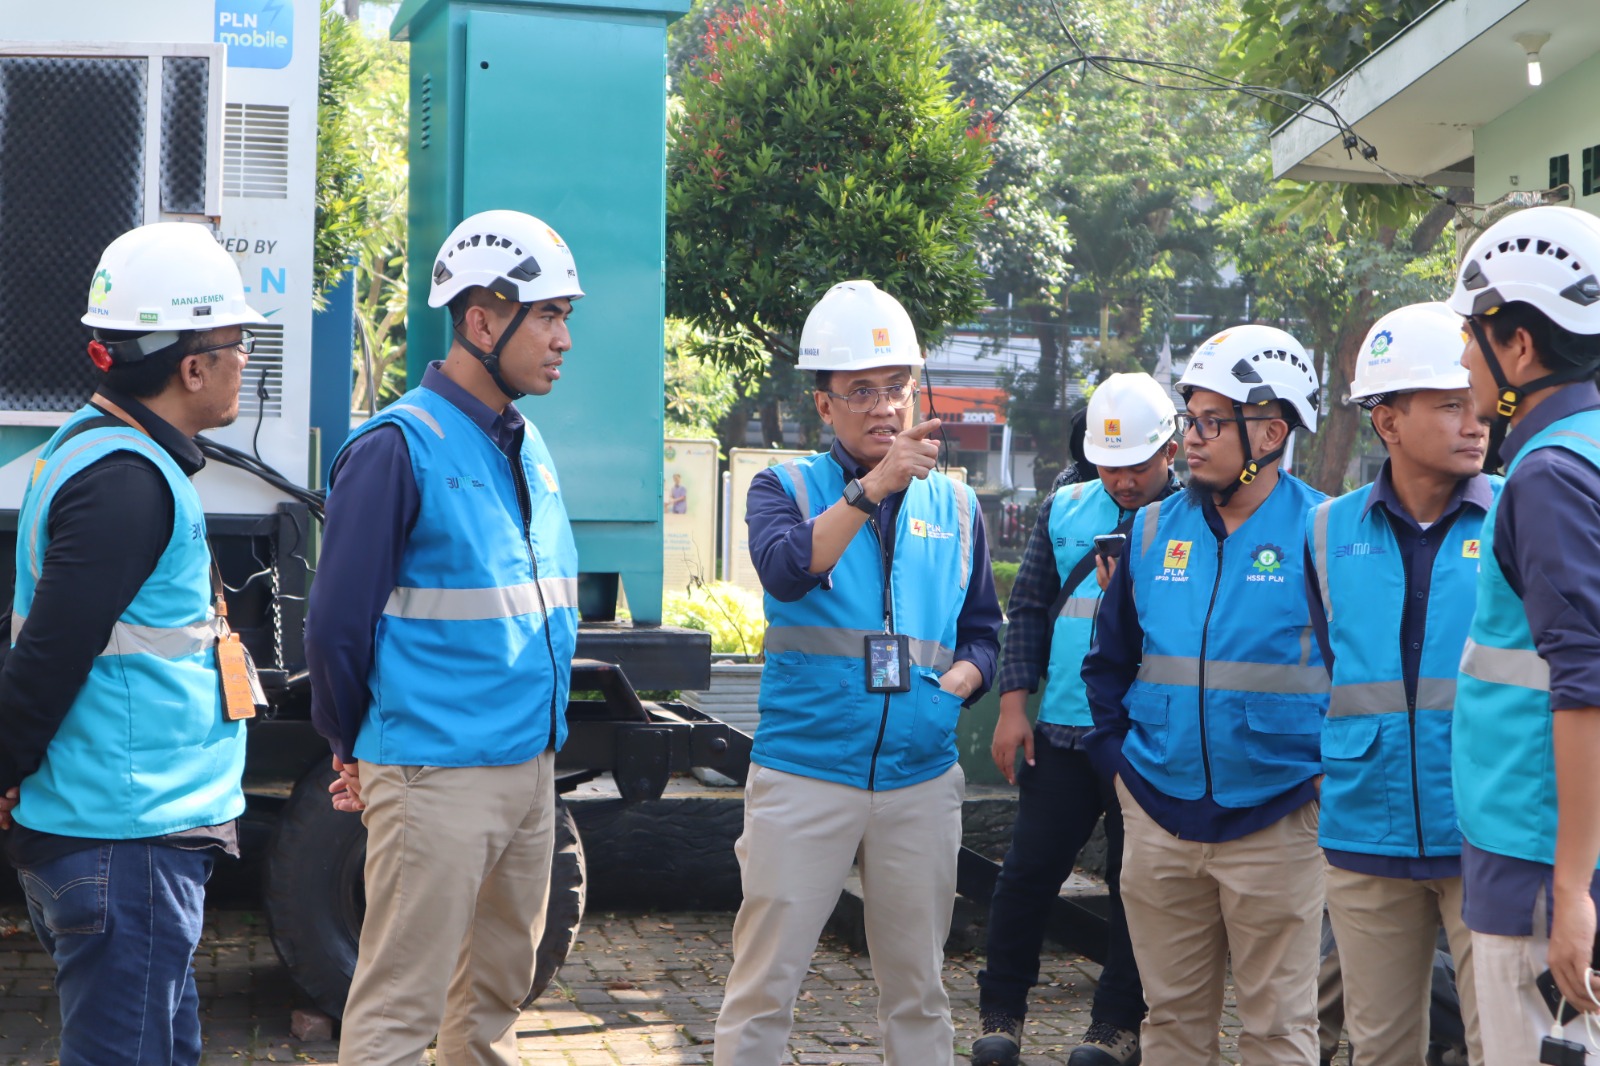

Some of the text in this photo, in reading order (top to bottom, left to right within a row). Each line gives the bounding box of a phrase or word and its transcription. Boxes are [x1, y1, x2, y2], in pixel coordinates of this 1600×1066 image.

[219, 12, 258, 28] PLN
[219, 30, 288, 49] mobile
[220, 238, 278, 255] ED BY
[171, 294, 225, 307] MANAJEMEN
[97, 308, 109, 316] PLN
[140, 313, 158, 321] MSA
[927, 522, 941, 533] PLN
[1163, 568, 1186, 576] PLN
[1246, 574, 1285, 583] HSSE PLN
